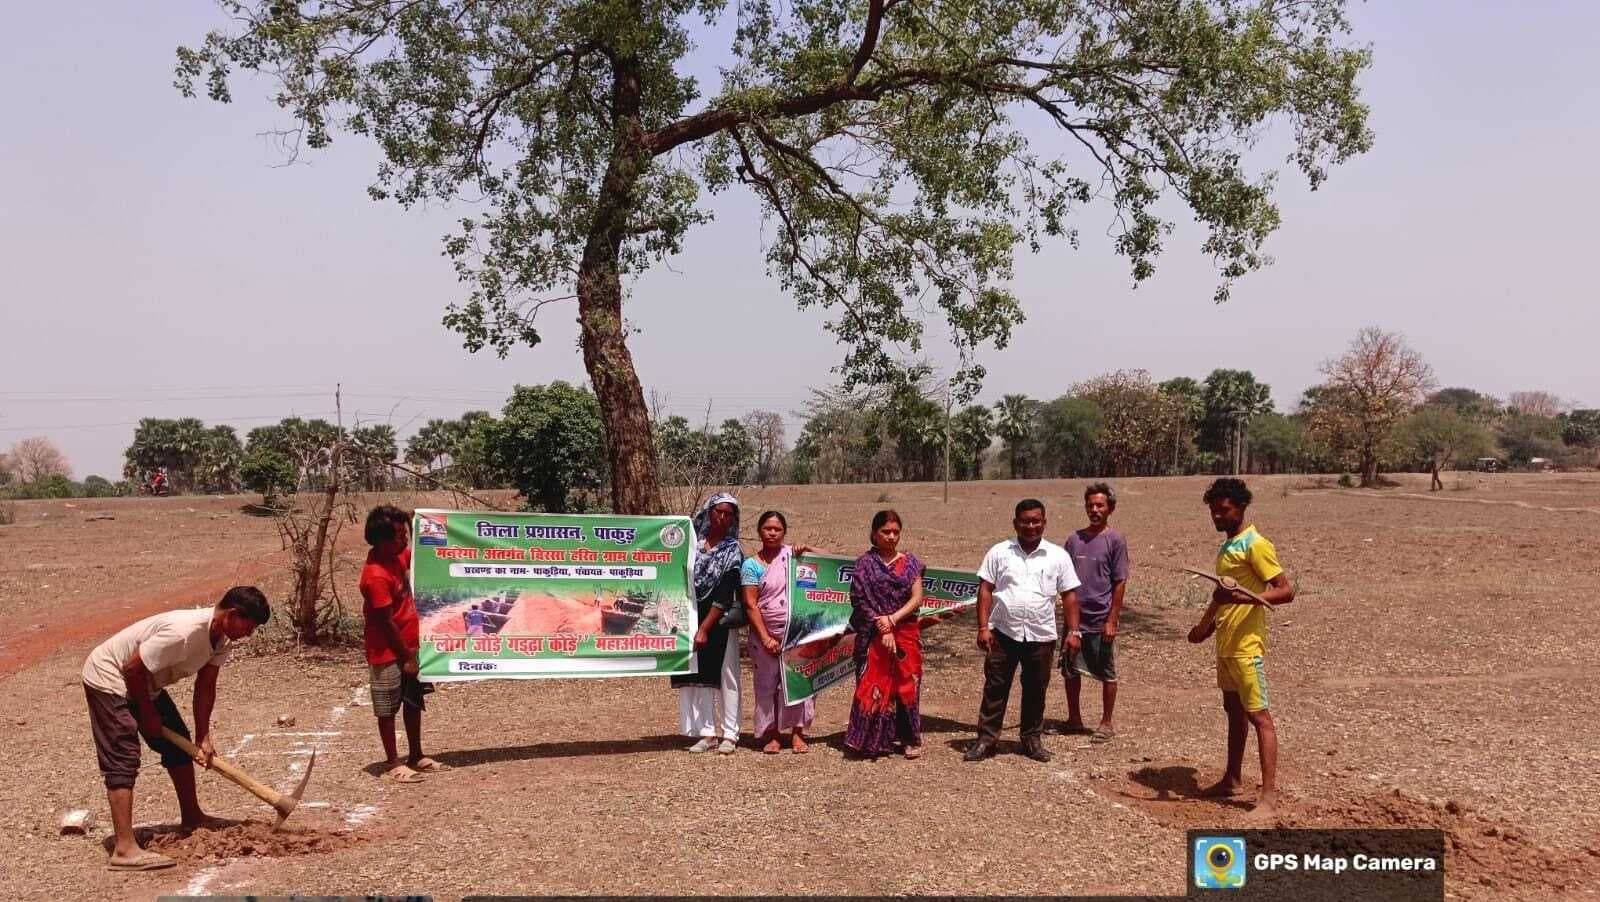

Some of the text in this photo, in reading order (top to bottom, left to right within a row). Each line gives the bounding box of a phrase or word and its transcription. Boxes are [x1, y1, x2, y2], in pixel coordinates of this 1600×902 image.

[475, 521, 637, 545] जिला प्रशासन, पाकुड़
[435, 546, 479, 560] मनरेगा
[530, 547, 566, 561] बिरसा
[570, 547, 599, 561] हरित
[602, 551, 628, 562] ग्राम
[632, 549, 673, 563] योजना
[495, 567, 507, 576] का
[805, 588, 846, 604] मनरेगा
[595, 634, 677, 651] महाअभियान
